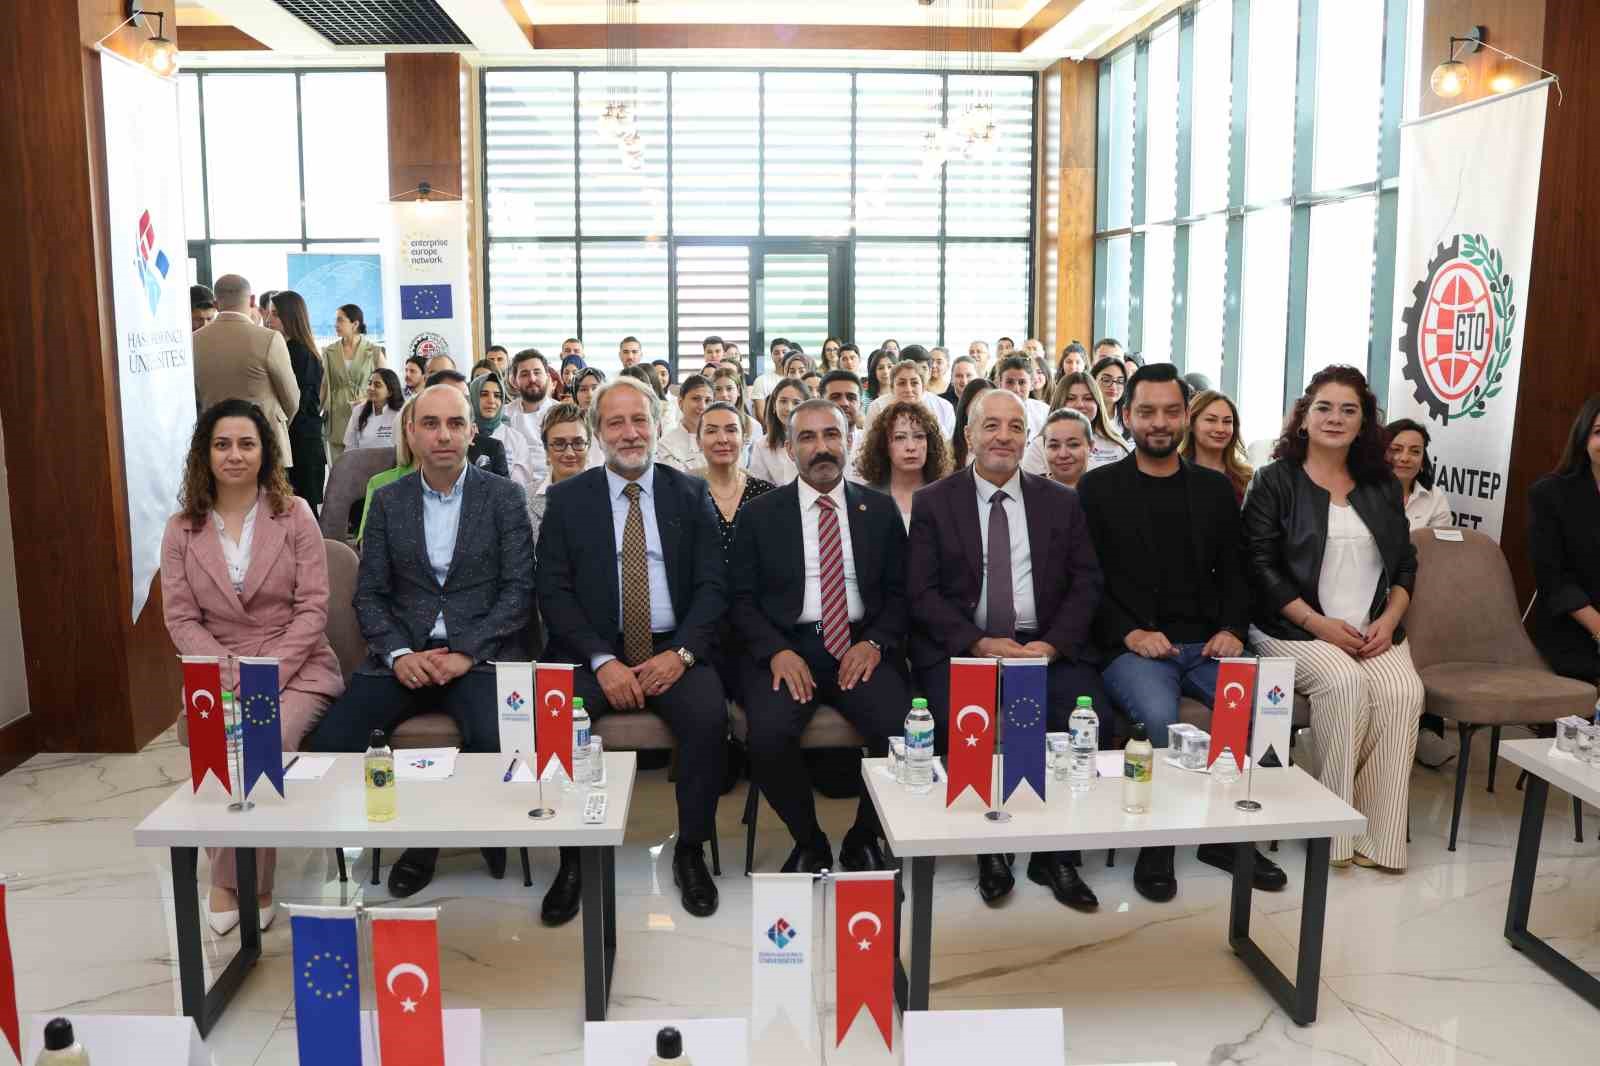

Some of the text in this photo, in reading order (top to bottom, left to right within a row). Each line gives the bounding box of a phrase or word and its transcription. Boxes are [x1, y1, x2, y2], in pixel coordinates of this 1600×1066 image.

[410, 239, 448, 248] enterprise
[410, 249, 438, 257] europe
[411, 256, 443, 264] network
[1455, 312, 1485, 351] GTO
[1432, 455, 1502, 500] İANTEP
